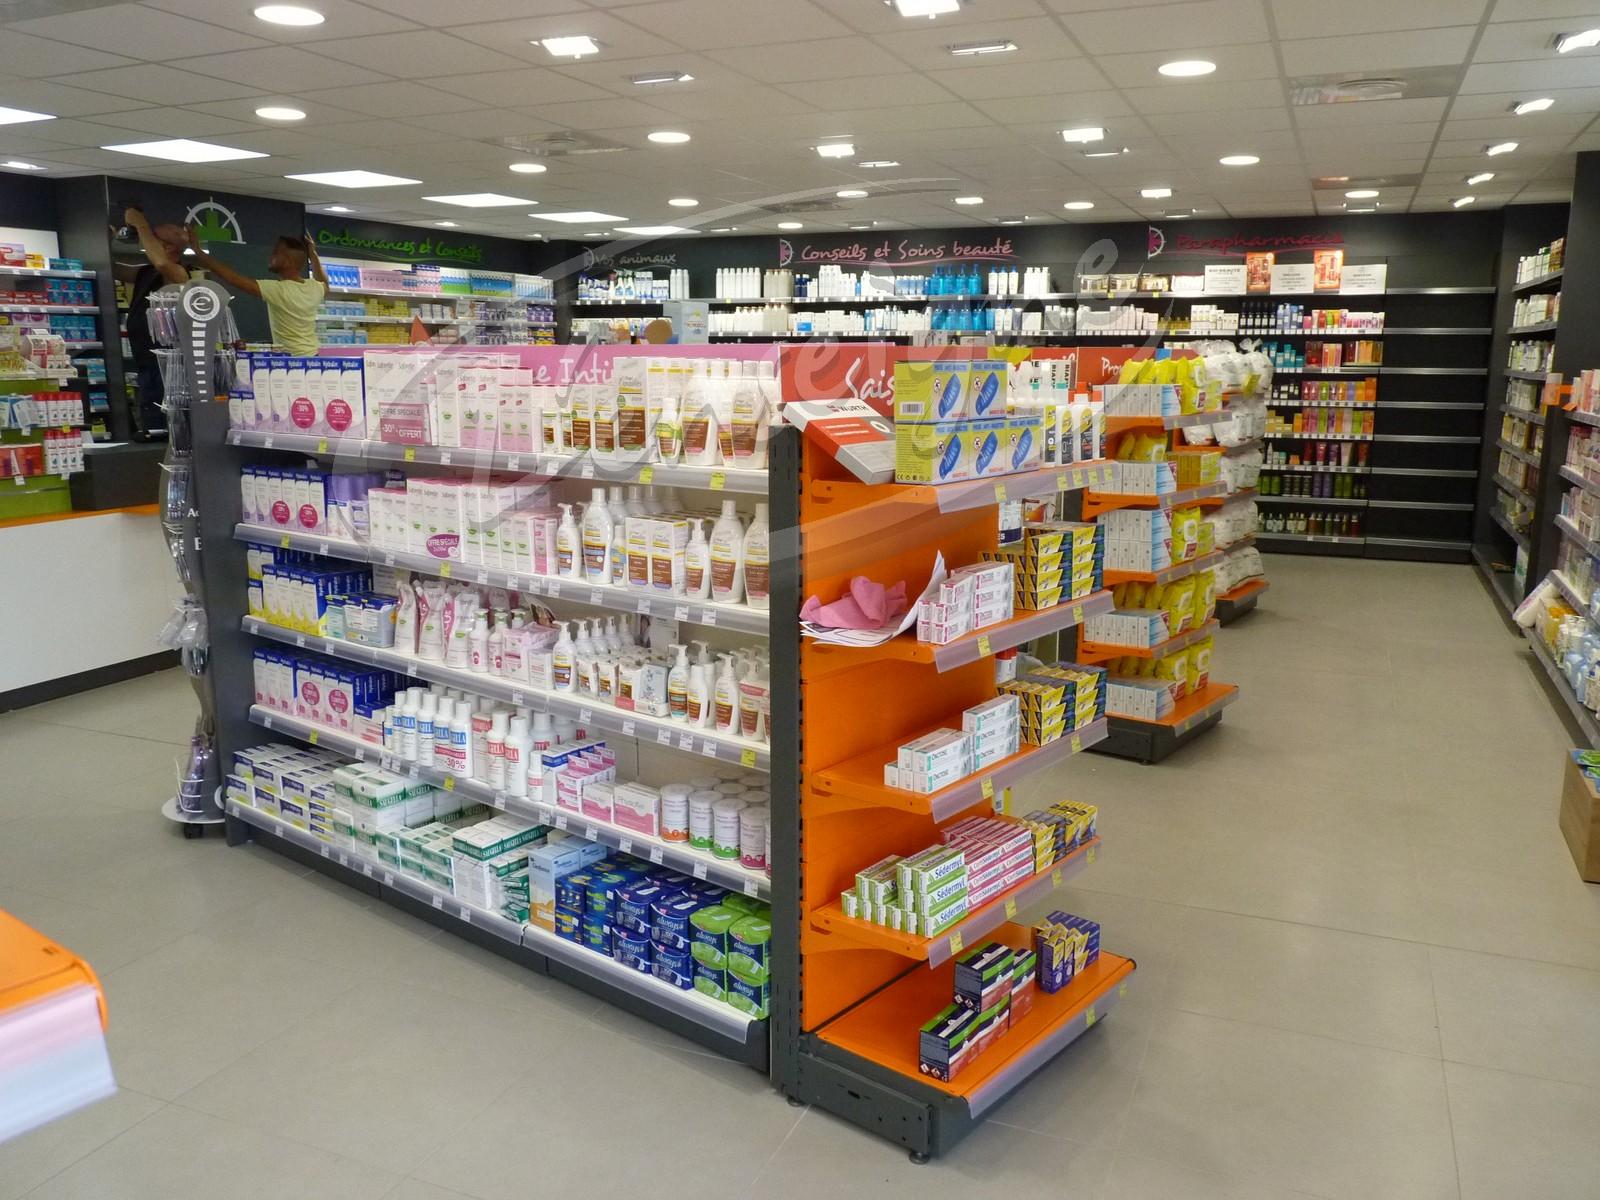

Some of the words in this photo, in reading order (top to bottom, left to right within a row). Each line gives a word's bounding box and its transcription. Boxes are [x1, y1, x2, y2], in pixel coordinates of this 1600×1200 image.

[318, 228, 416, 254] Ordonnances
[419, 238, 433, 254] et
[435, 241, 482, 262] Conseils
[801, 243, 867, 261] Conseils
[874, 240, 889, 258] et
[899, 240, 946, 259] Soins
[953, 237, 1014, 256] beauté
[1174, 232, 1345, 254] Parapharmacie
[620, 251, 677, 265] animaux
[559, 352, 614, 384] Inti
[1101, 356, 1122, 377] Pro
[935, 855, 963, 879] Sédermyl
[937, 877, 966, 901] Sédermyl
[620, 901, 642, 915] always
[940, 899, 967, 922] Sédermyl
[656, 915, 681, 930] always
[695, 931, 718, 945] always
[617, 939, 641, 954] always
[733, 941, 755, 956] always
[655, 953, 678, 968] always
[697, 966, 718, 980] always
[733, 981, 755, 997] always
